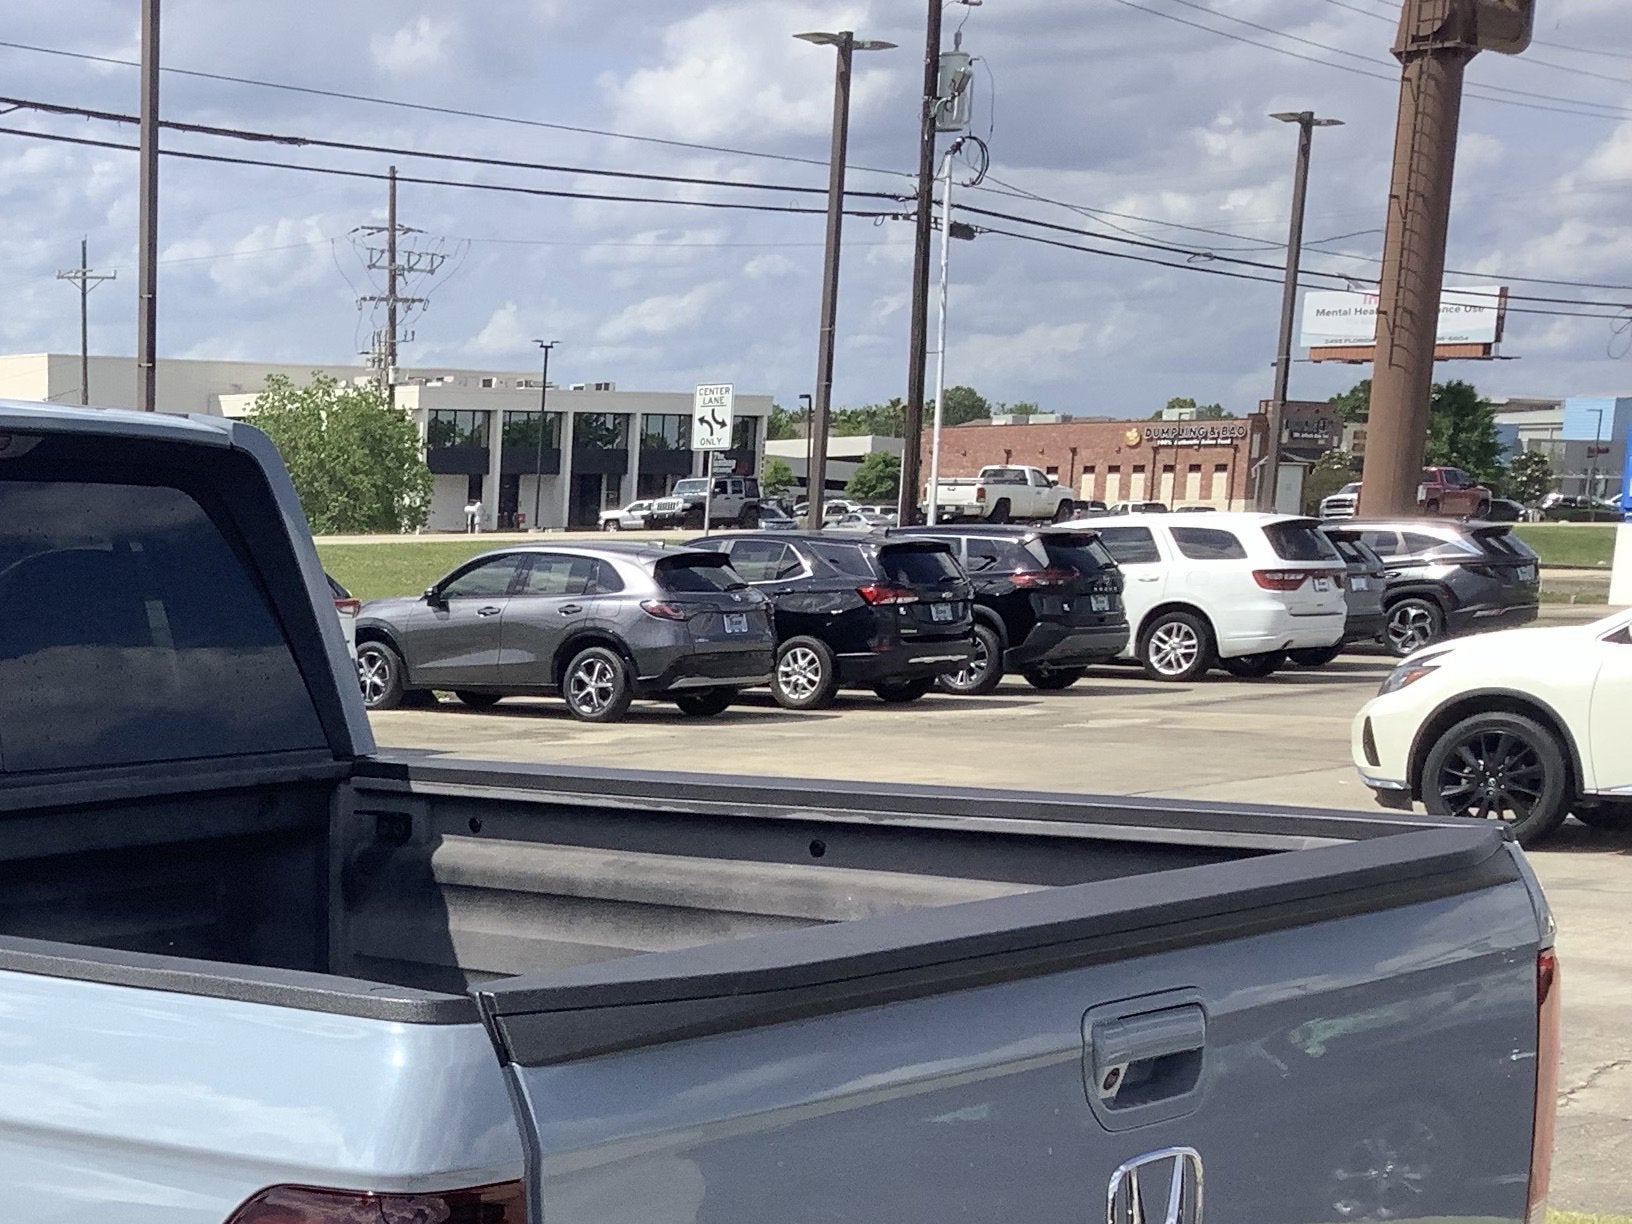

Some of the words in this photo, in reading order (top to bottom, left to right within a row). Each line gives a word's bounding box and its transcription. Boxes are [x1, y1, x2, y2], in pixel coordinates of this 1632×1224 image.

[1316, 307, 1351, 317] Mental
[698, 387, 730, 396] CENTER
[702, 396, 725, 405] LANE
[1144, 427, 1207, 439] DUMPLING
[1208, 426, 1220, 438] &
[1221, 425, 1247, 438] BAO
[700, 437, 722, 446] ONLY
